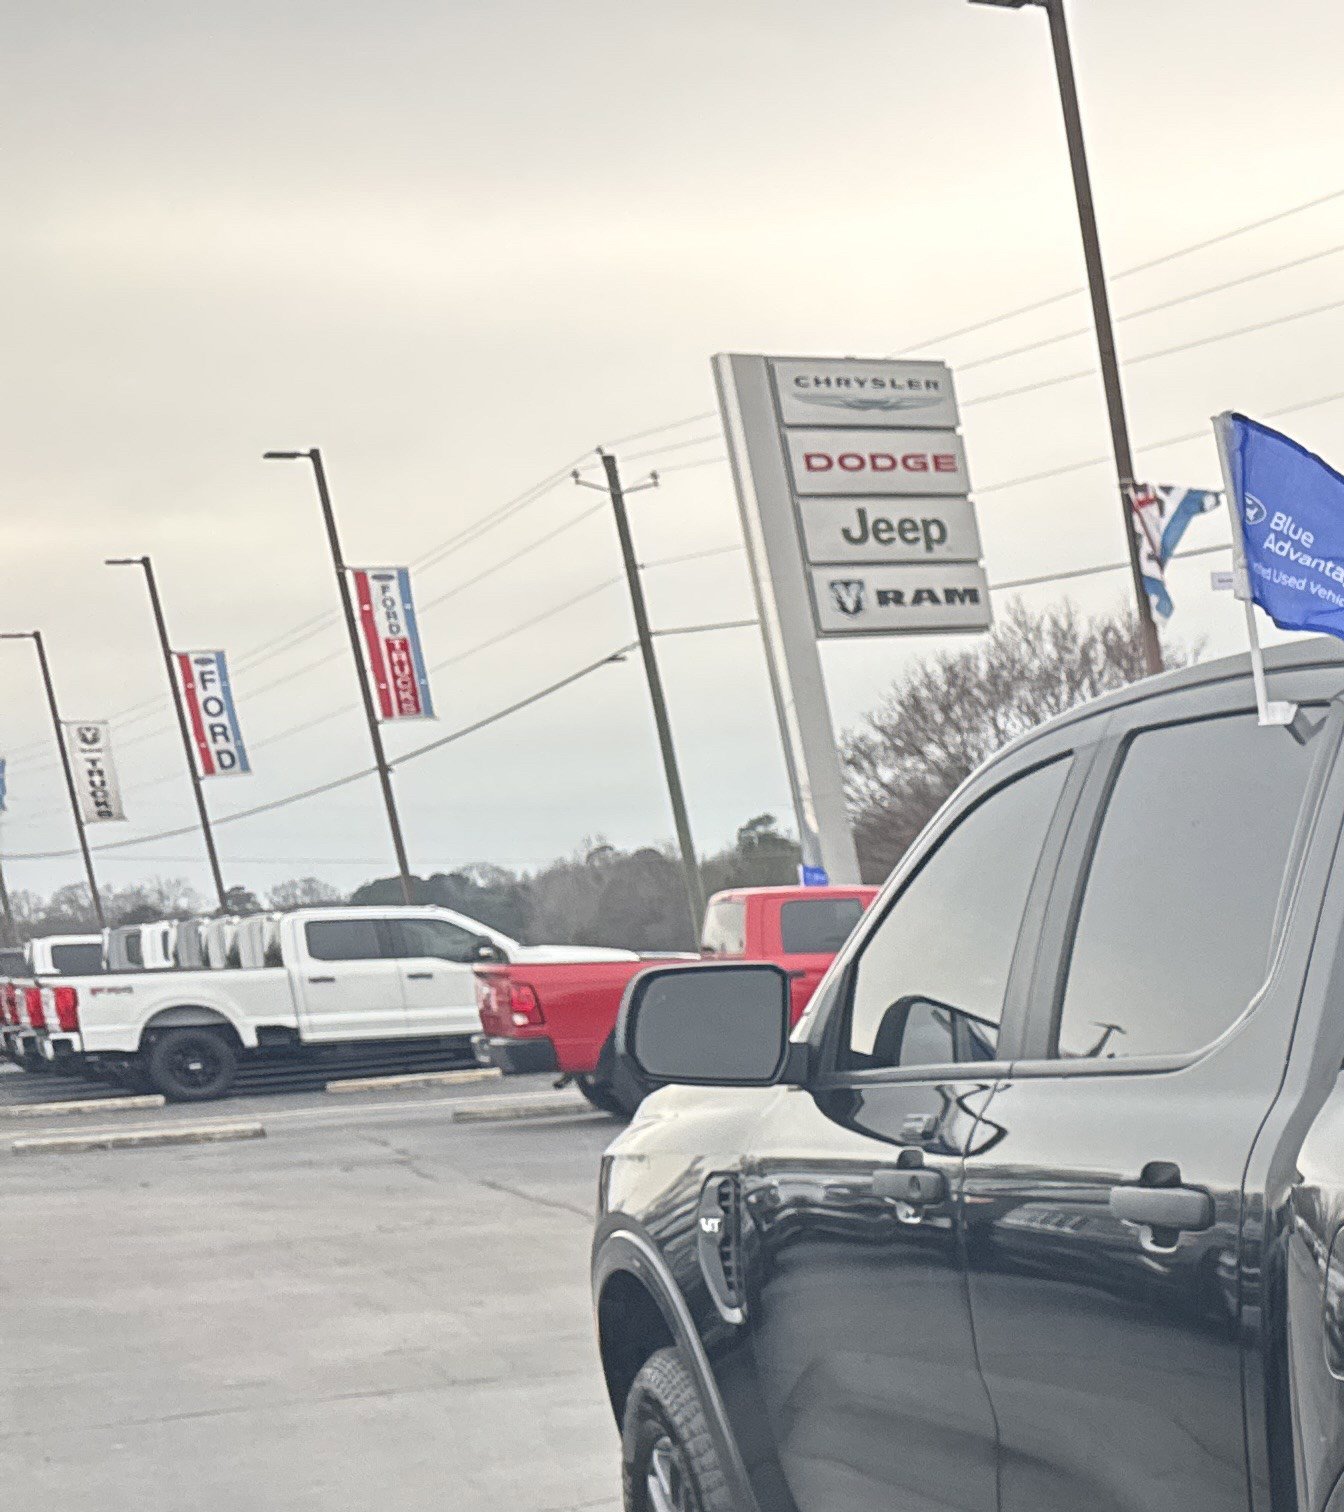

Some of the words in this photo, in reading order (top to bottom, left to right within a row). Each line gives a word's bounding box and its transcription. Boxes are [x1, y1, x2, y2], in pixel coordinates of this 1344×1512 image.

[793, 375, 941, 391] CHRYSLER
[803, 452, 958, 473] DODGE
[841, 506, 948, 553] Jeep
[1269, 511, 1315, 549] Blue
[1273, 568, 1307, 591] Used
[380, 583, 401, 636] FORD
[876, 587, 981, 608] RAM
[199, 670, 236, 771] FORD
